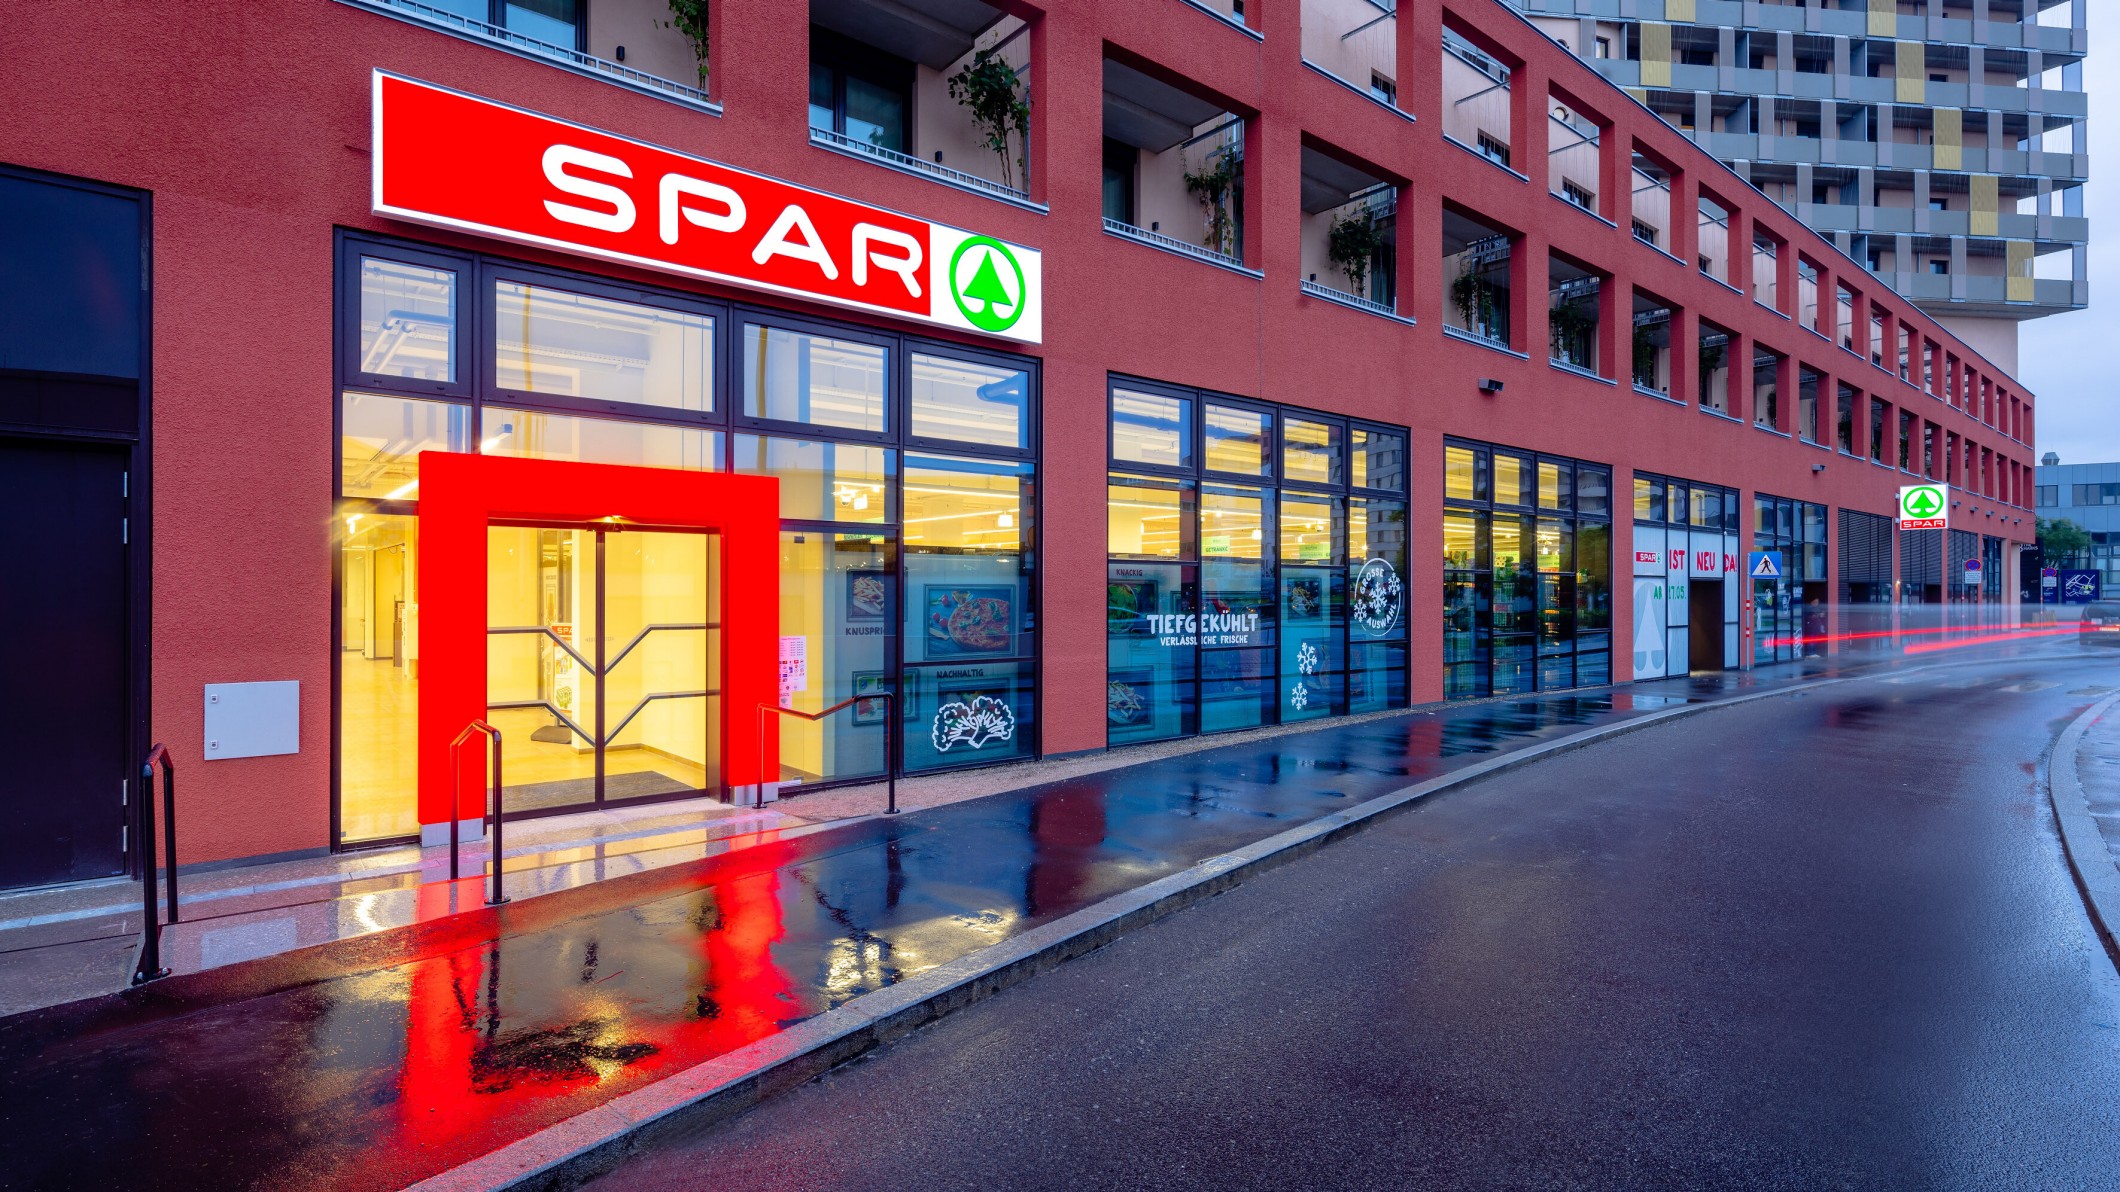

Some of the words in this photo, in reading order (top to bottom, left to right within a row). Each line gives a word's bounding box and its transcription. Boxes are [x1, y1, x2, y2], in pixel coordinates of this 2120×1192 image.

[542, 144, 922, 298] SPAR
[1640, 553, 1656, 561] SPAR
[1669, 549, 1685, 570] IST
[1697, 551, 1715, 571] NEU
[1360, 568, 1384, 594] GROSSE
[1146, 610, 1258, 634] TIEFGEKÜHLT
[1366, 604, 1397, 628] AUSWAHL
[845, 626, 884, 635] KNUSPRI
[1160, 635, 1217, 646] VERLÄSSLICHE
[1220, 634, 1248, 644] FRISCHE
[936, 669, 984, 678] NACHHALTIG
